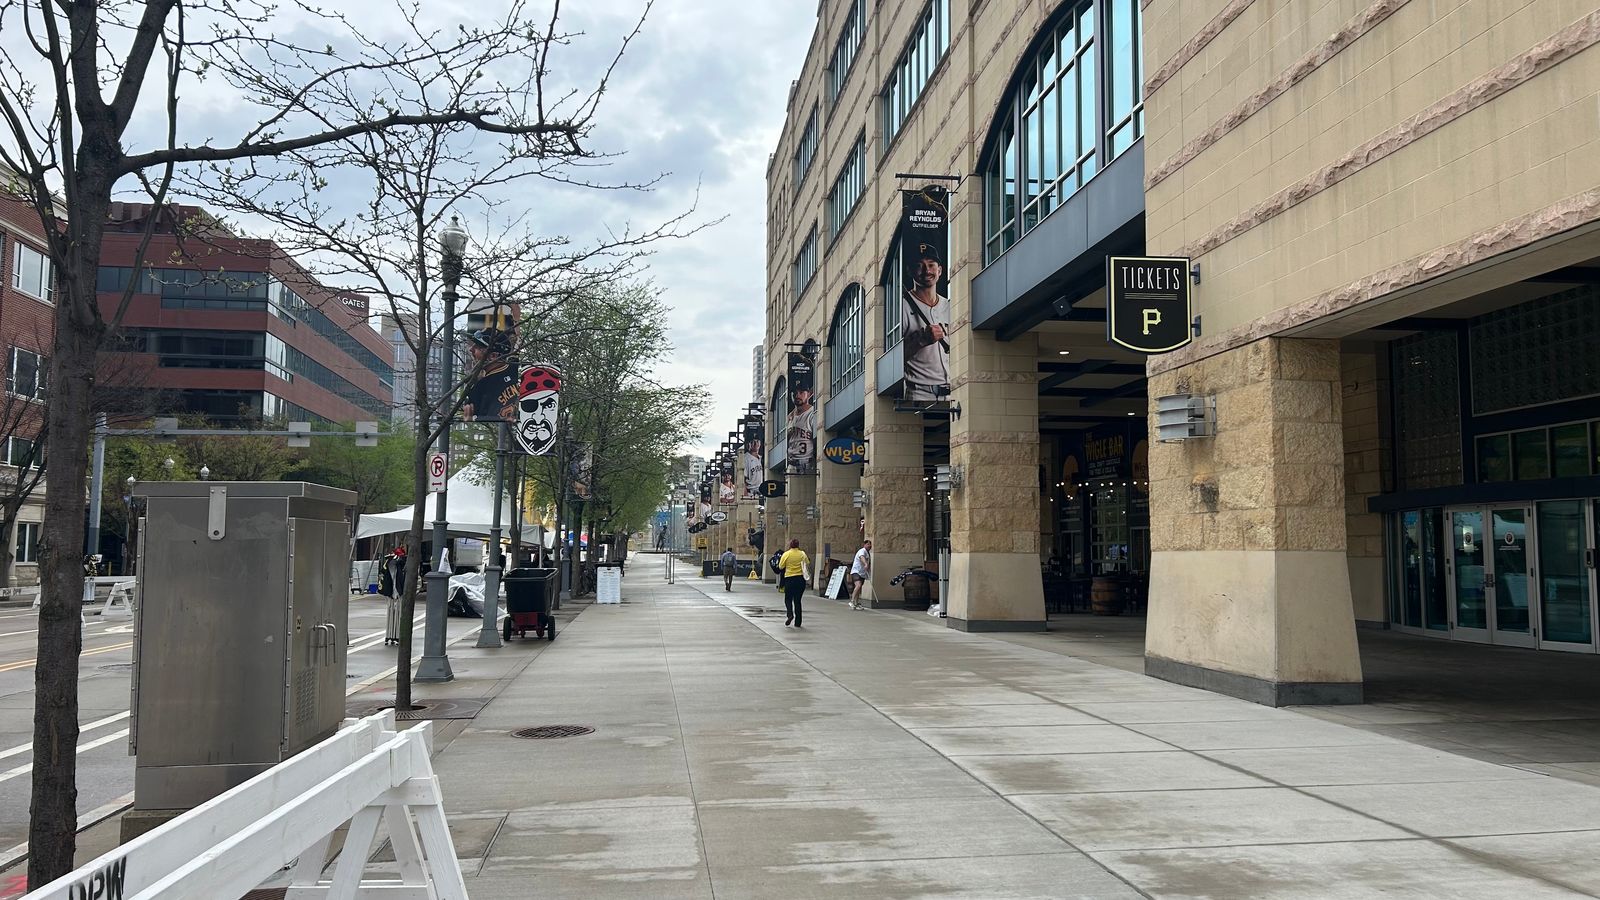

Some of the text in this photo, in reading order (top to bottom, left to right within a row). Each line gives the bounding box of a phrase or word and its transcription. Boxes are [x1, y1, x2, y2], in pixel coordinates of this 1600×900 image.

[1121, 266, 1180, 290] TICKETS
[342, 298, 365, 308] GATES
[1142, 308, 1162, 335] P
[798, 442, 808, 455] 3
[1086, 435, 1124, 462] WIGLE BAR
[767, 482, 777, 495] P
[69, 855, 127, 900] DPW
